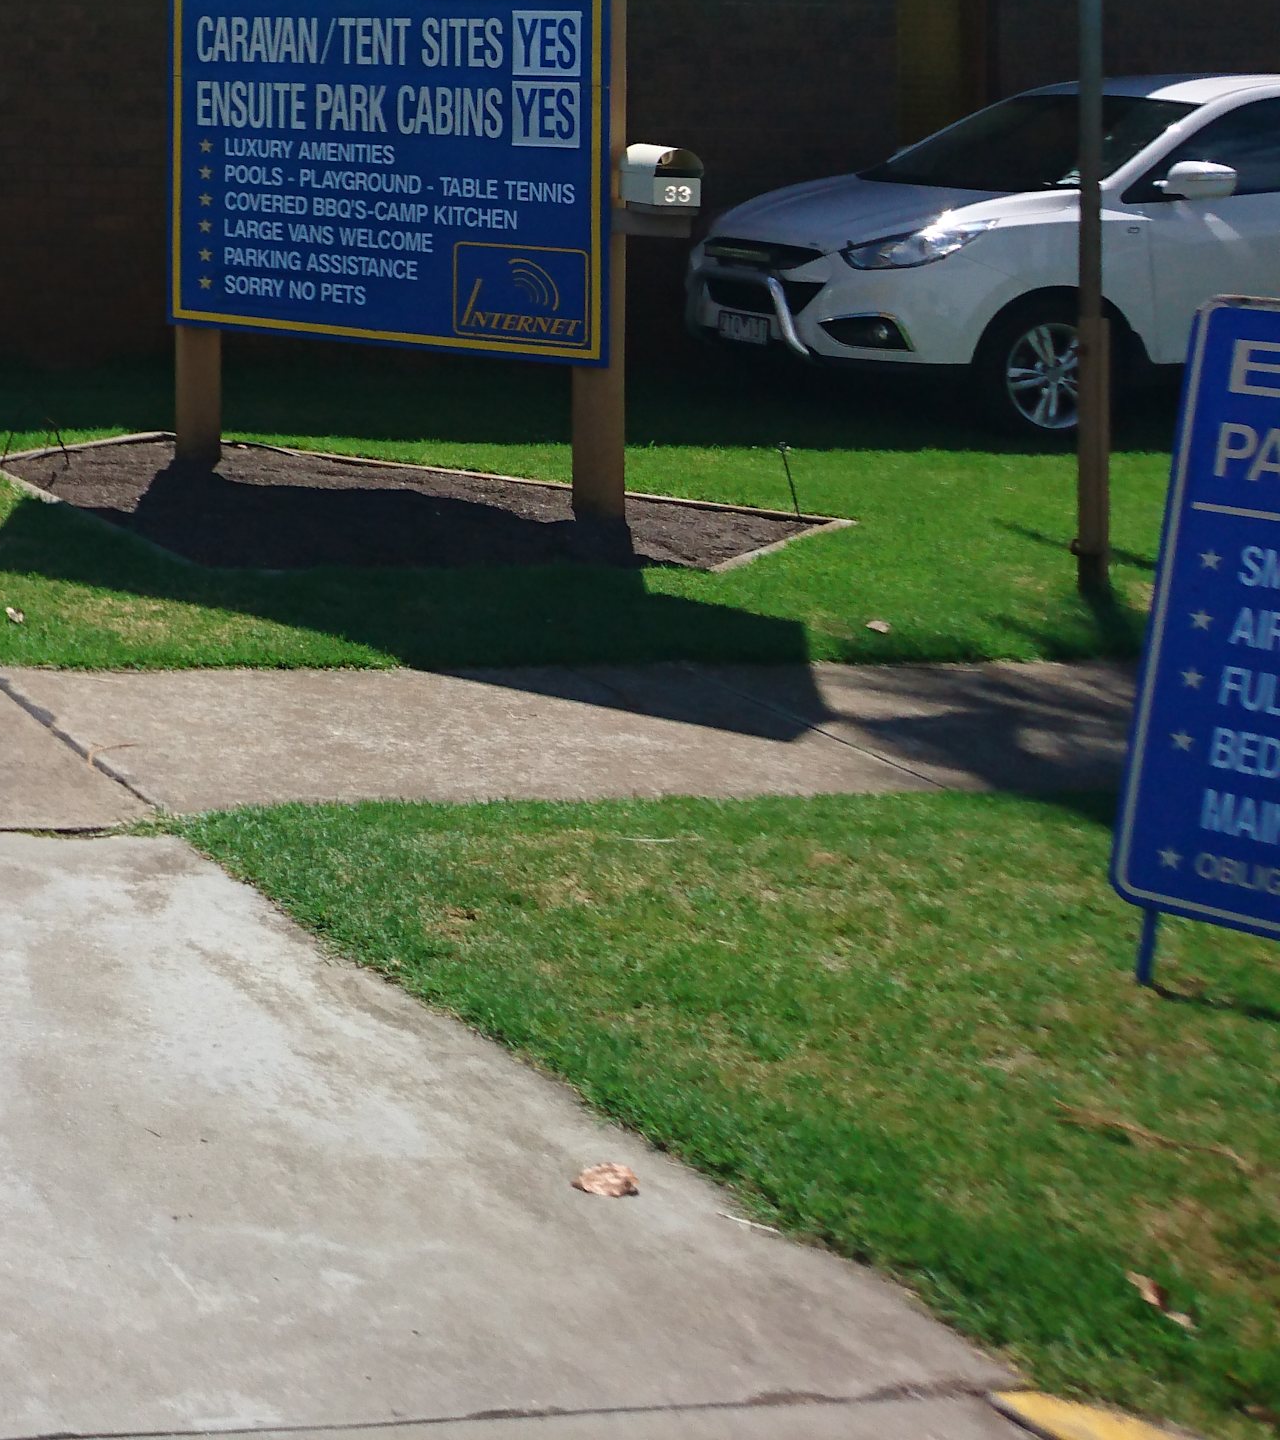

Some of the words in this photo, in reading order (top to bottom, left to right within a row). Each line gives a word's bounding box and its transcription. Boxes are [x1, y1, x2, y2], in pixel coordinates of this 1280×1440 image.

[422, 17, 503, 68] SITES
[517, 18, 576, 70] YES
[197, 81, 306, 130] ENSUITE
[316, 83, 388, 133] PARK
[397, 86, 502, 138] CABINS
[516, 87, 575, 139] YES
[224, 137, 293, 159] LUXURY
[298, 140, 395, 164] AMENITIES
[225, 165, 283, 186] POOLS
[299, 169, 422, 194] PLAYGROUND
[440, 177, 498, 200] TABLE
[505, 180, 575, 204] TENNIS
[665, 186, 691, 202] 33
[225, 192, 308, 215] COVERED
[434, 206, 518, 229] KITCHEN
[225, 219, 283, 241] LARGE
[289, 224, 334, 245] VANS
[339, 227, 433, 252] WELCOME
[225, 248, 300, 271] PARKING
[306, 252, 418, 280] ASSISTANCE
[225, 276, 284, 297] SORRY
[289, 280, 315, 300] NO
[321, 283, 366, 305] PETS
[461, 279, 581, 336] INTERNET
[1209, 727, 1280, 778] BED
